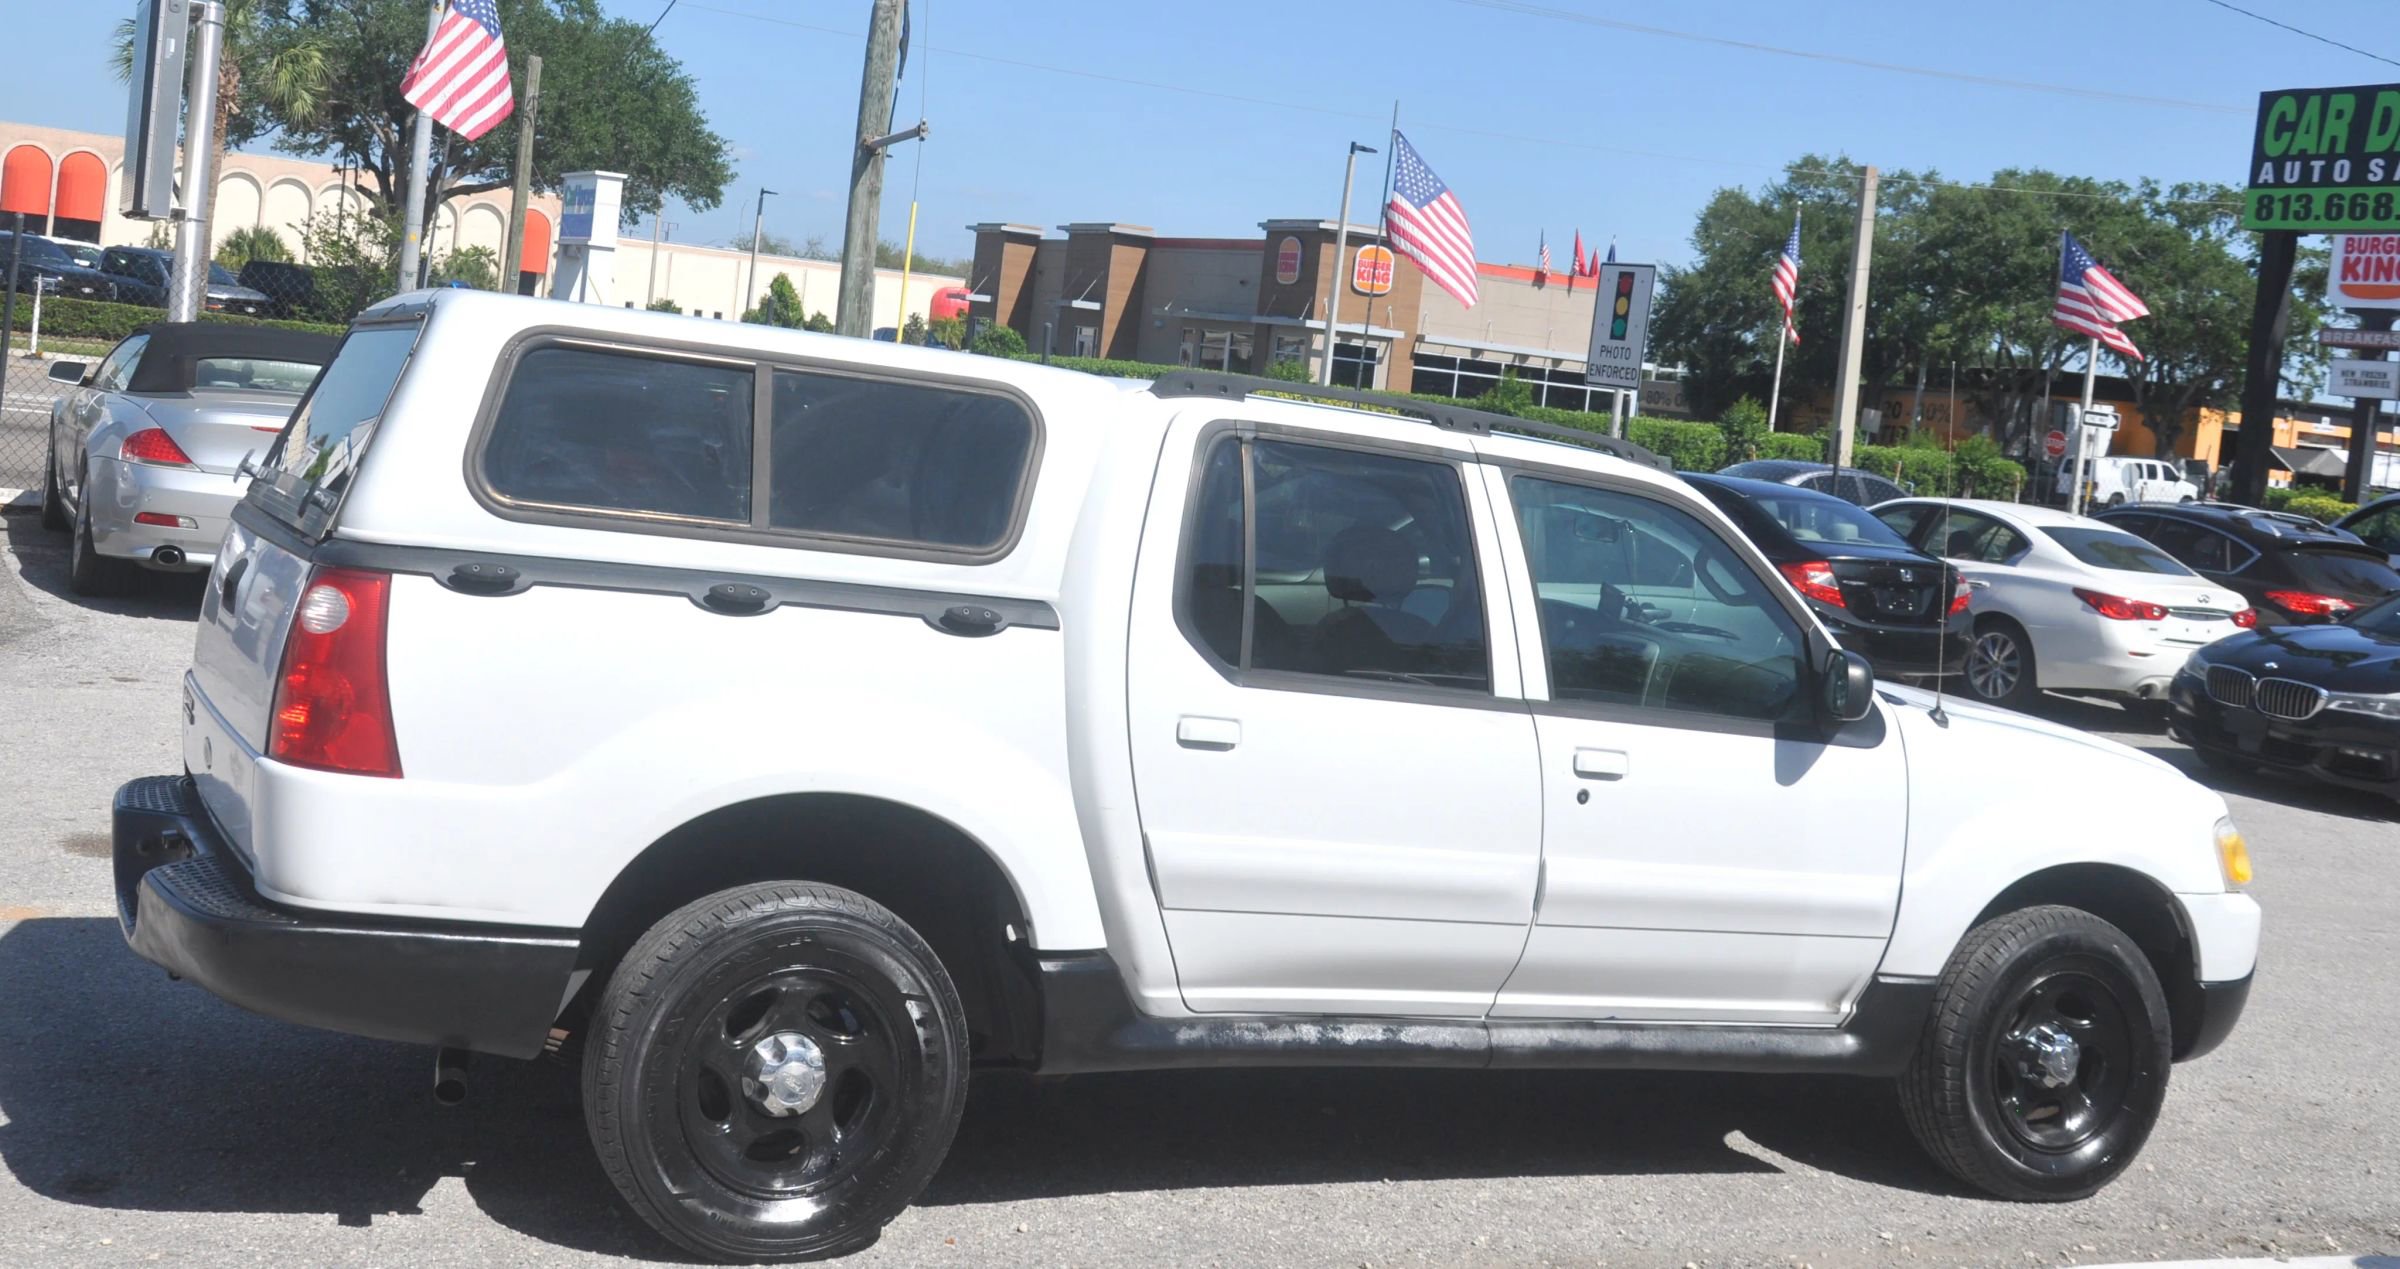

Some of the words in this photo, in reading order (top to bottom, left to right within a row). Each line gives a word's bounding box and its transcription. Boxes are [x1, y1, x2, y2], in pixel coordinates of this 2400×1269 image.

[2263, 93, 2356, 157] CAR
[2364, 90, 2400, 153] D
[2257, 159, 2351, 184] AUTO
[1358, 259, 1391, 272] BURGER
[1357, 268, 1390, 284] KING
[1600, 345, 1631, 361] PHOTO
[1589, 363, 1637, 380] ENFORCED
